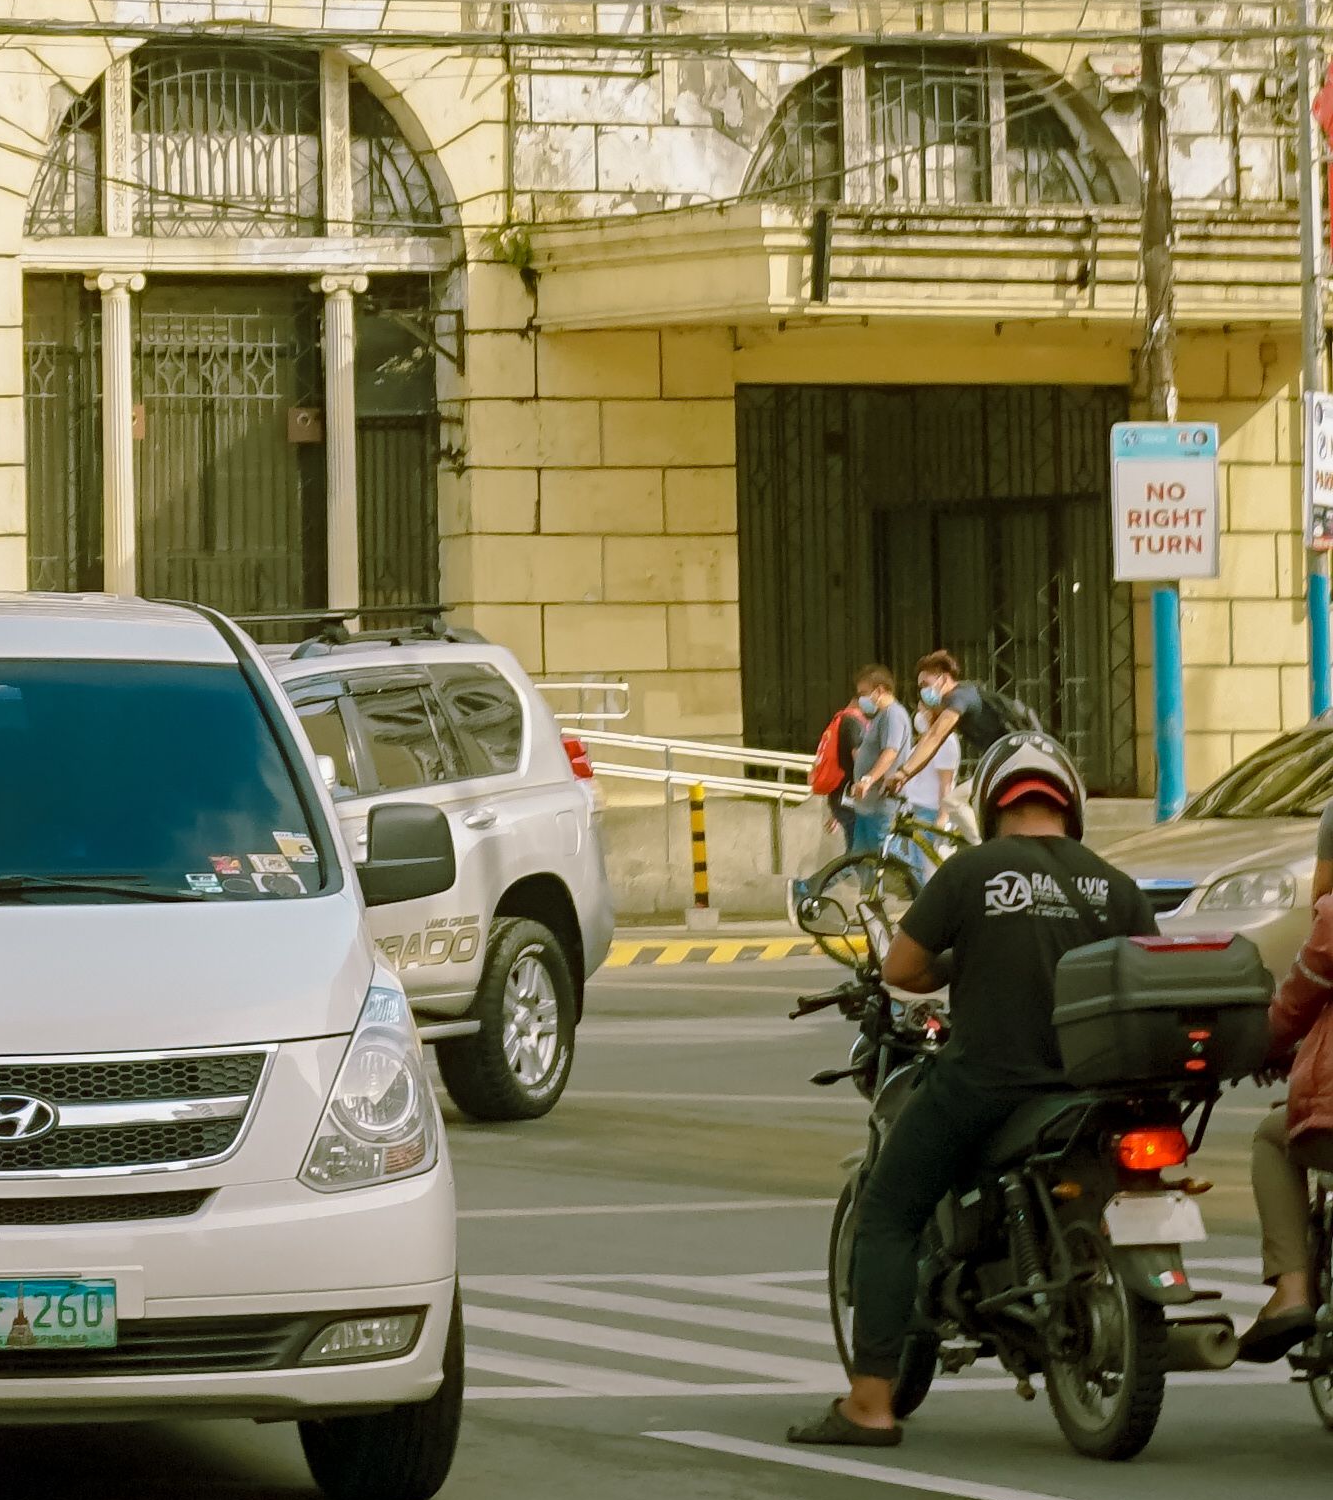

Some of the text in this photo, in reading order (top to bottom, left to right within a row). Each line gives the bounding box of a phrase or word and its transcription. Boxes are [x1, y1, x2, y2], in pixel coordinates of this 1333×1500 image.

[1145, 481, 1186, 502] NO
[1126, 508, 1207, 528] RIGHT
[1129, 534, 1203, 555] TURN
[374, 926, 481, 971] RADO
[33, 1290, 104, 1329] 260
